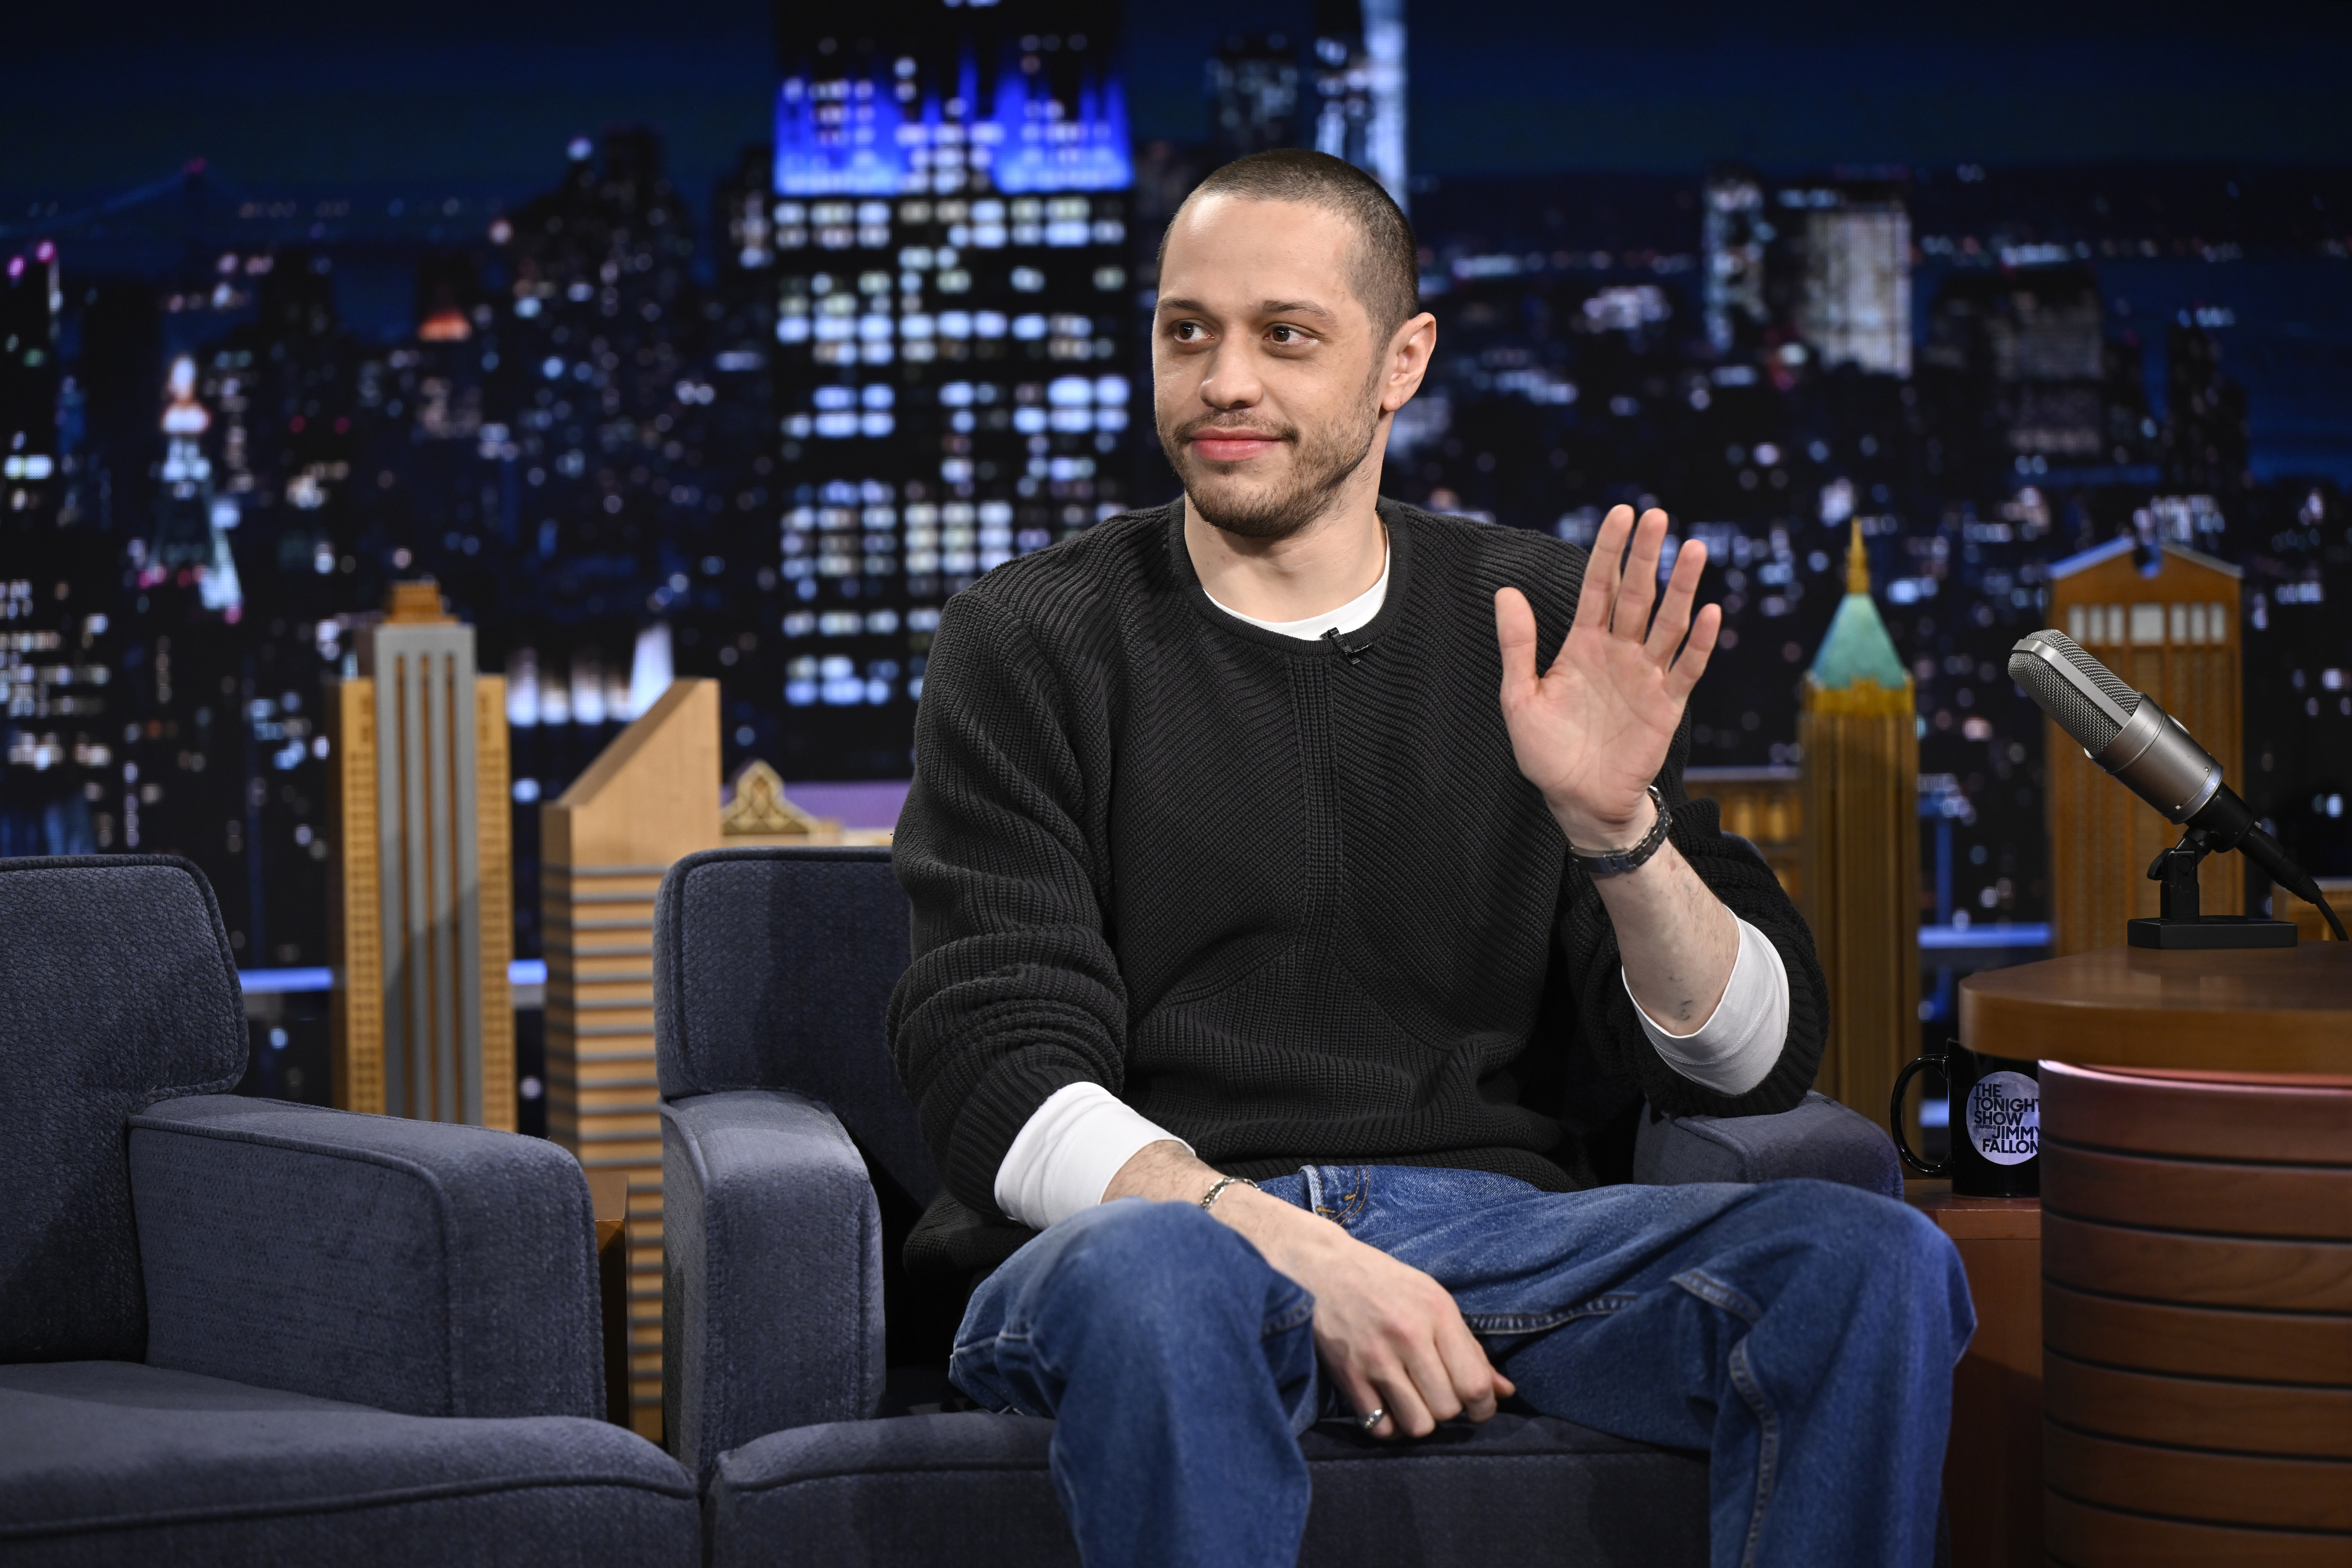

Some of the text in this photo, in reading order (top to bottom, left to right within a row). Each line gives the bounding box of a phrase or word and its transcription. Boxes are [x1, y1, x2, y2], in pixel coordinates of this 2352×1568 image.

[1976, 1083, 2002, 1098] THE
[1974, 1110, 2023, 1126] SHOW
[1982, 1138, 2039, 1153] FALLON
